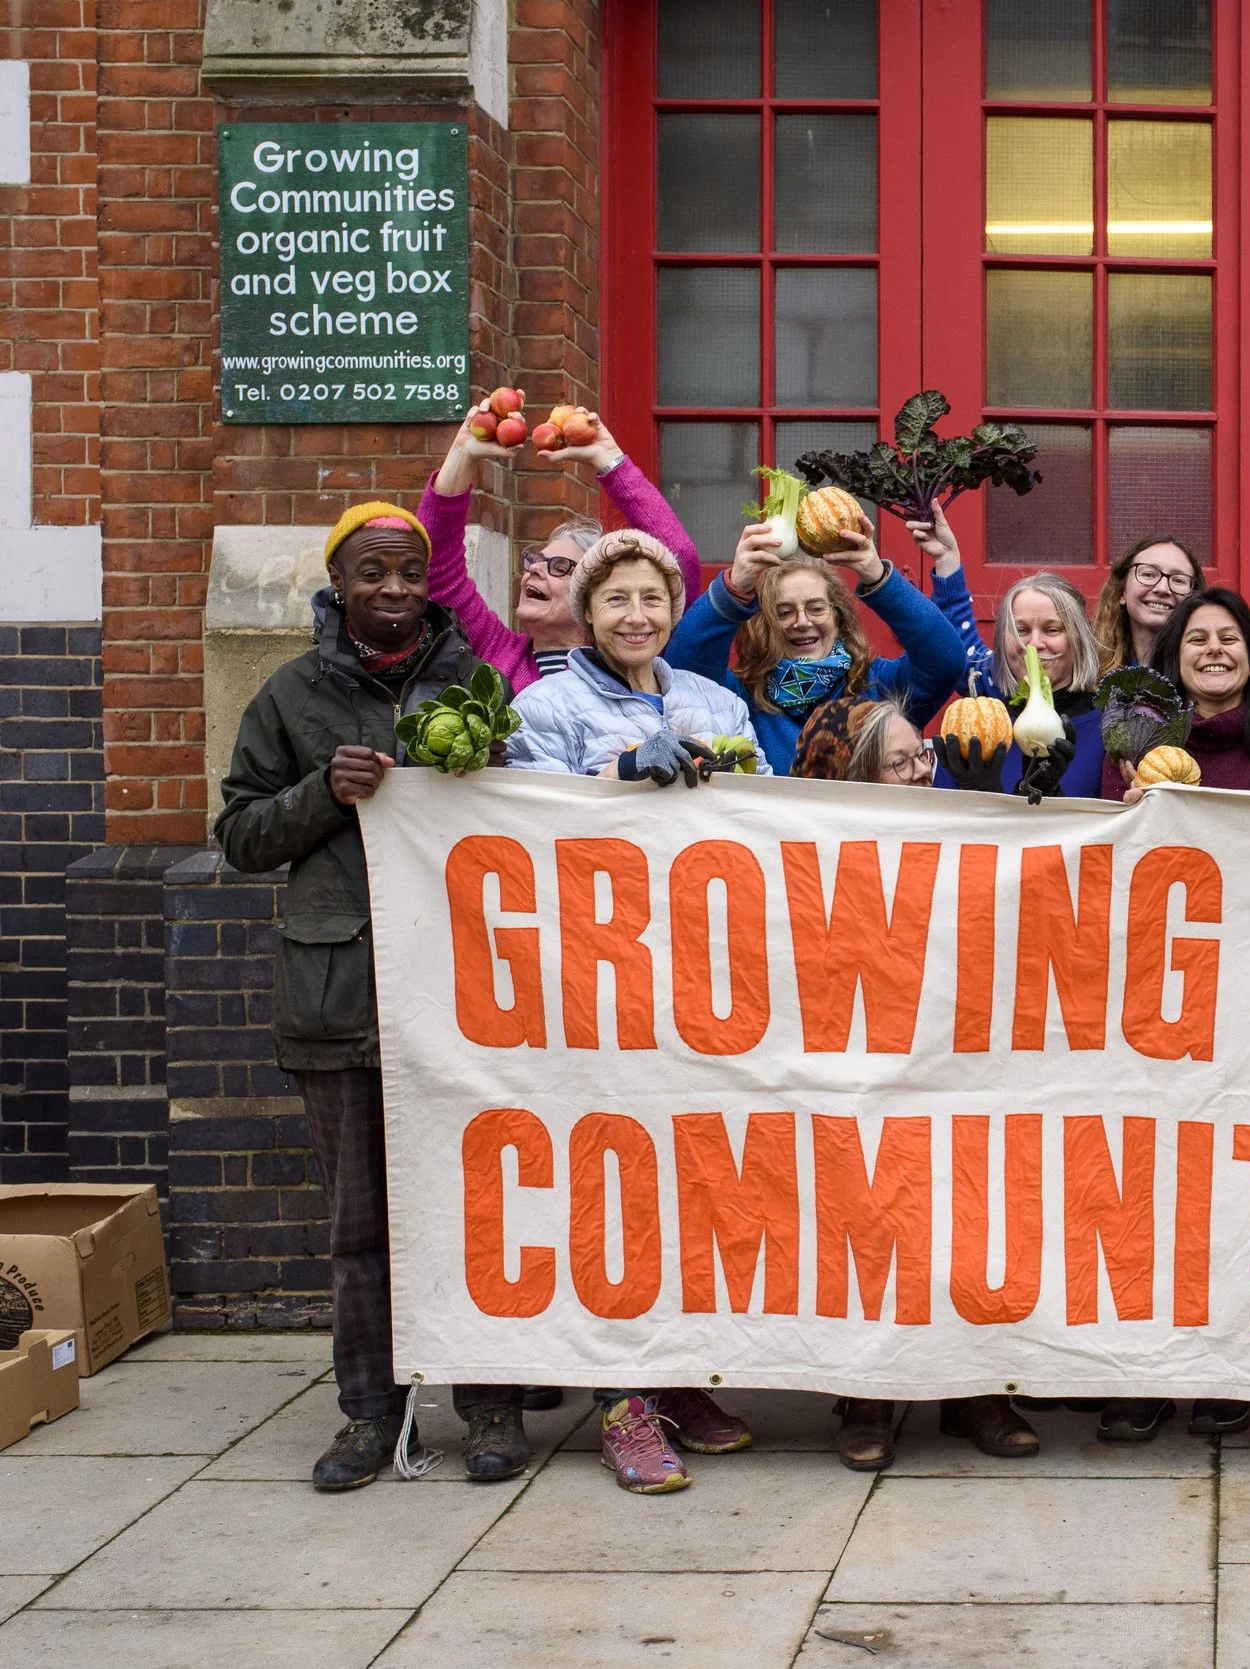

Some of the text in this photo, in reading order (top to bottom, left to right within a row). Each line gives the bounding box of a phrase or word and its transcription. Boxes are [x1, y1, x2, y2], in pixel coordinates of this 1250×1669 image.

[253, 140, 419, 181] Growing
[230, 181, 455, 214] Communities
[236, 220, 447, 262] organic fruit
[230, 261, 452, 302] and veg box
[269, 303, 418, 336] scheme
[222, 350, 466, 374] www.growingcommunities.org
[234, 383, 460, 401] Tel. 0207 502 7588
[445, 834, 1223, 1062] GROWING
[6, 1264, 45, 1311] Produce
